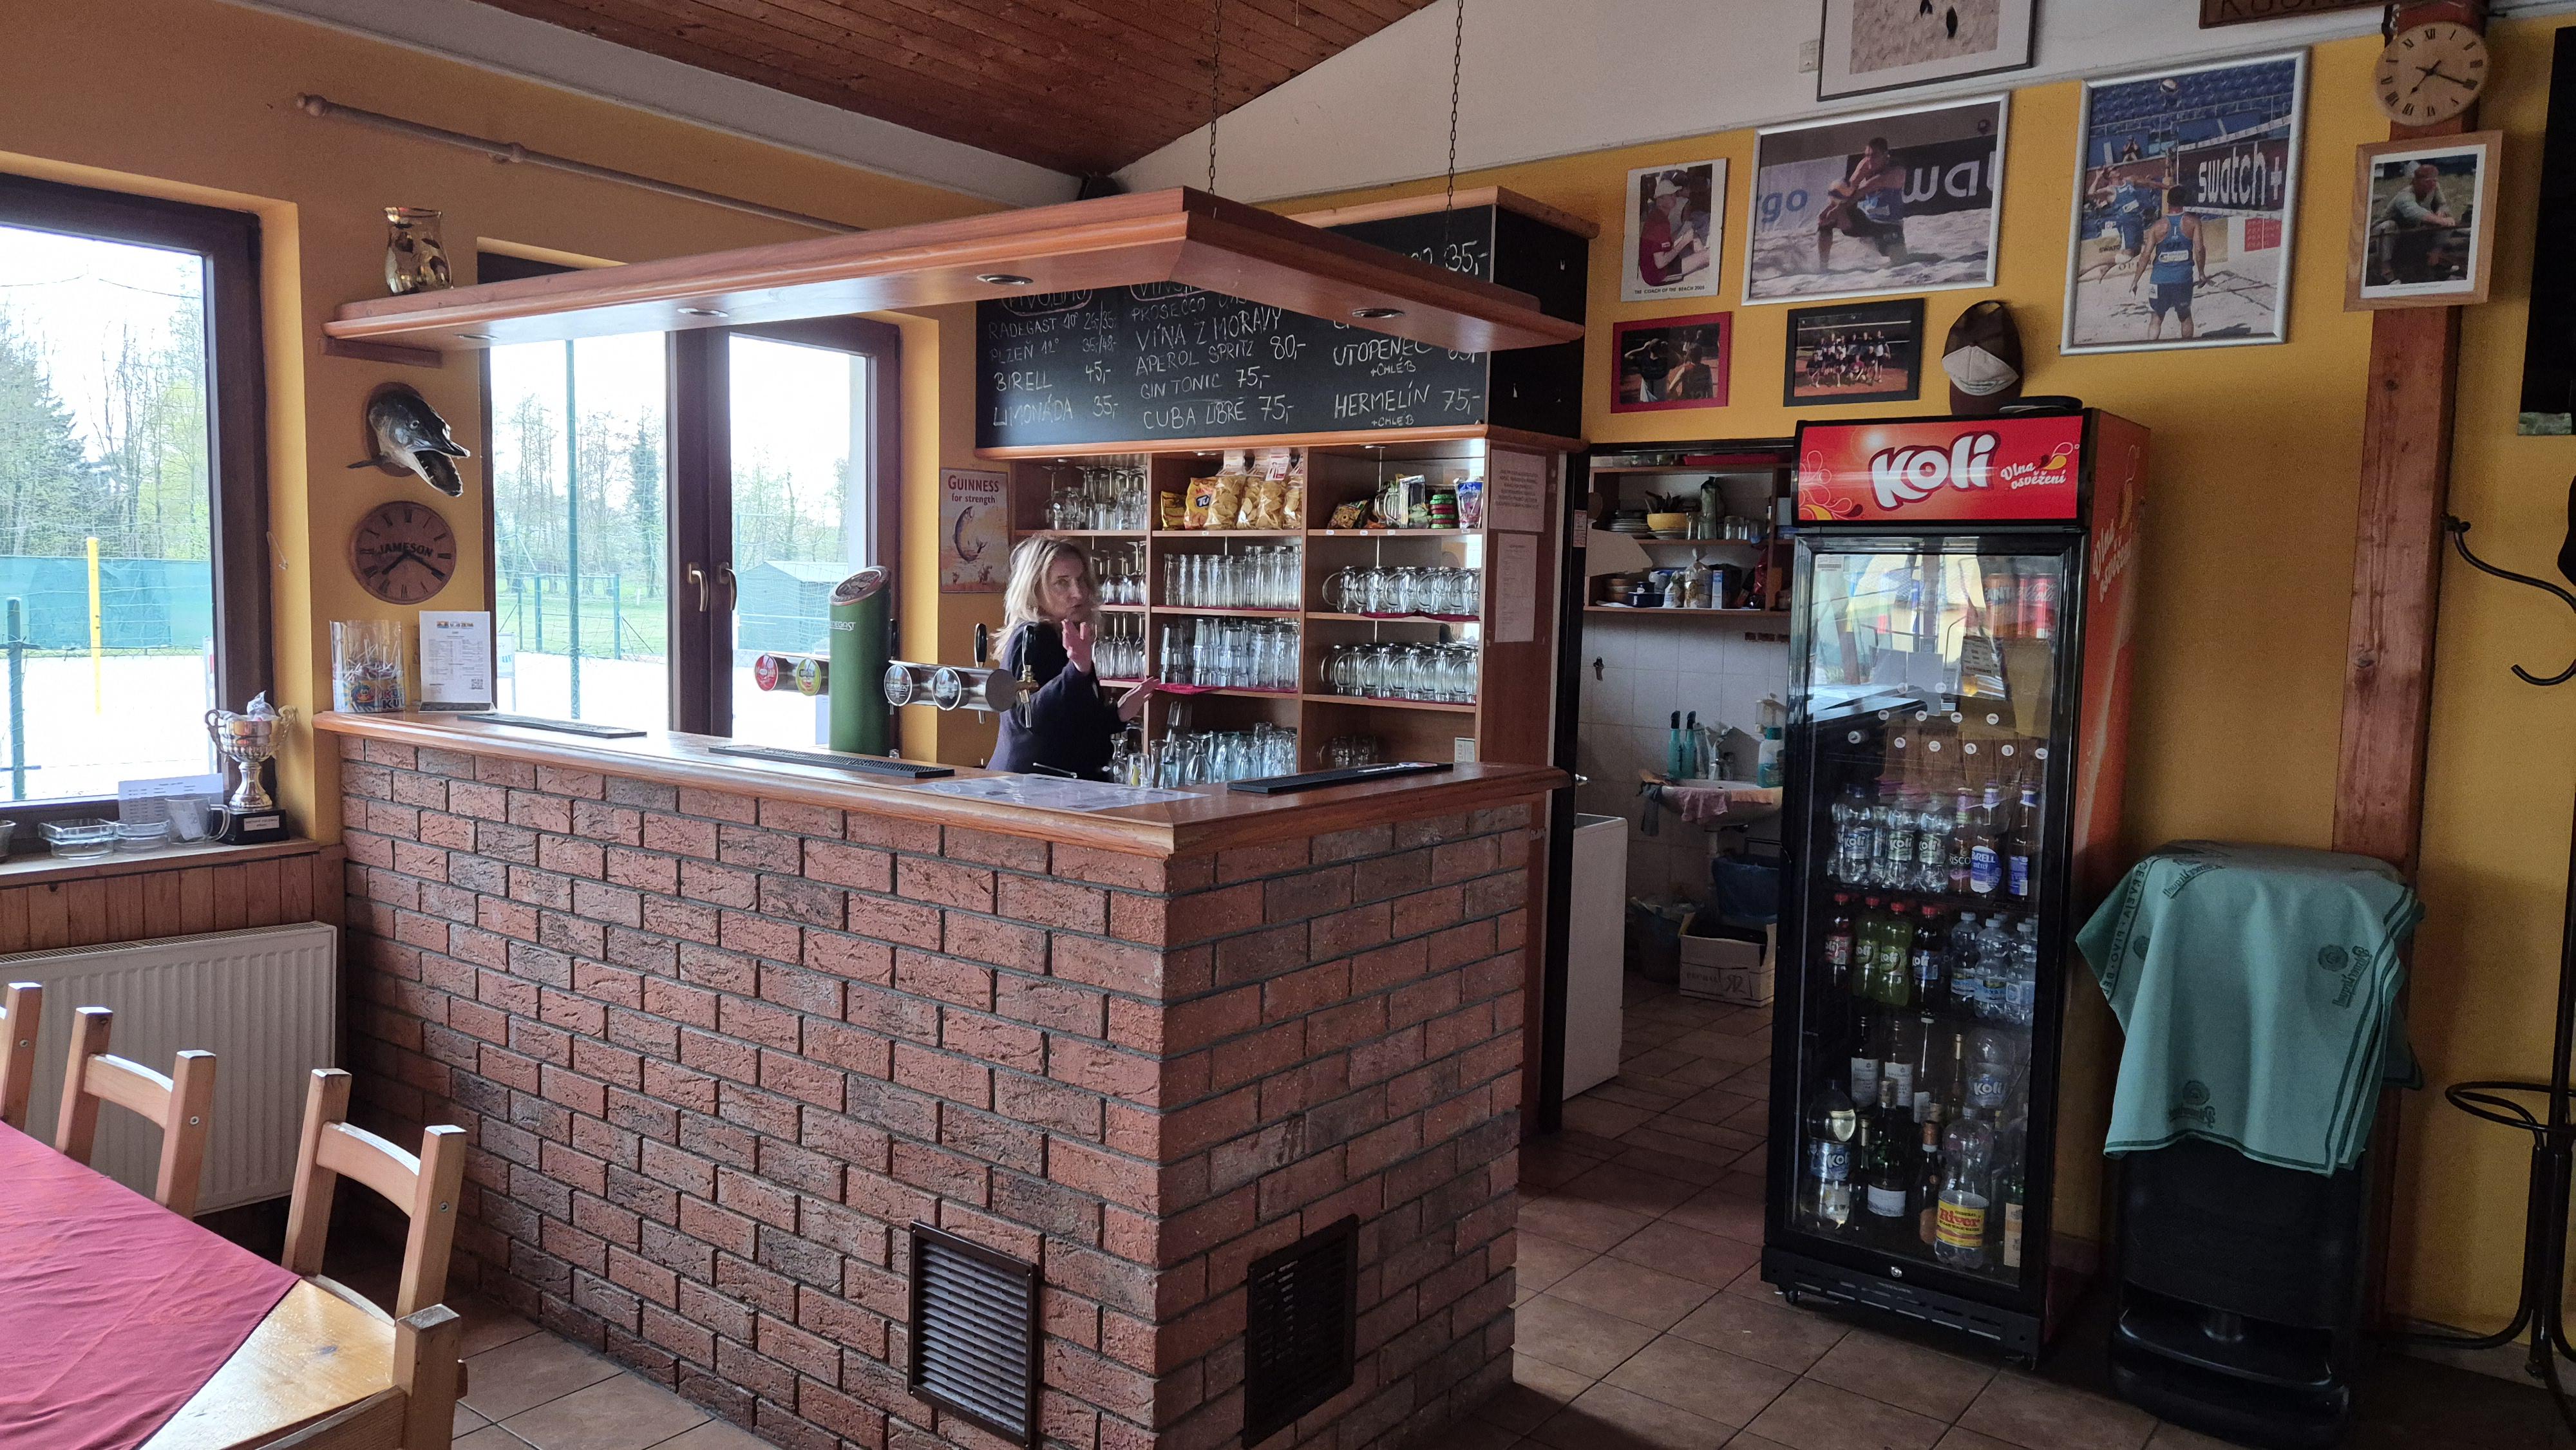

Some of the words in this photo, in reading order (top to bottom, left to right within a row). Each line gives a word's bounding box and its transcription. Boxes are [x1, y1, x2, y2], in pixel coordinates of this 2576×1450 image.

[2197, 140, 2266, 206] swatch
[1759, 188, 1808, 223] go
[989, 317, 1057, 339] RADEGAST
[1135, 323, 1187, 352] VÍNA
[1213, 305, 1282, 341] MORAVY
[1135, 350, 1200, 376] APEROL
[1208, 339, 1255, 364] SPRITZ
[1270, 334, 1307, 361] 80,-
[993, 370, 1053, 391] BIRELL
[1085, 361, 1112, 384] 45,-
[1140, 383, 1166, 400] GIN
[1170, 373, 1222, 394] TONIC
[1236, 366, 1271, 390] 75,-
[1093, 395, 1119, 420] 35,-
[1144, 406, 1196, 429] CUBA
[1258, 394, 1294, 424] 75,-
[1334, 380, 1430, 419] HERMELÍN
[1441, 388, 1481, 415] 75,-
[948, 475, 999, 493] GUINNESS
[1871, 433, 1997, 509] Koli
[951, 493, 963, 502] for
[965, 494, 996, 505] strength
[380, 541, 434, 558] JAMESON
